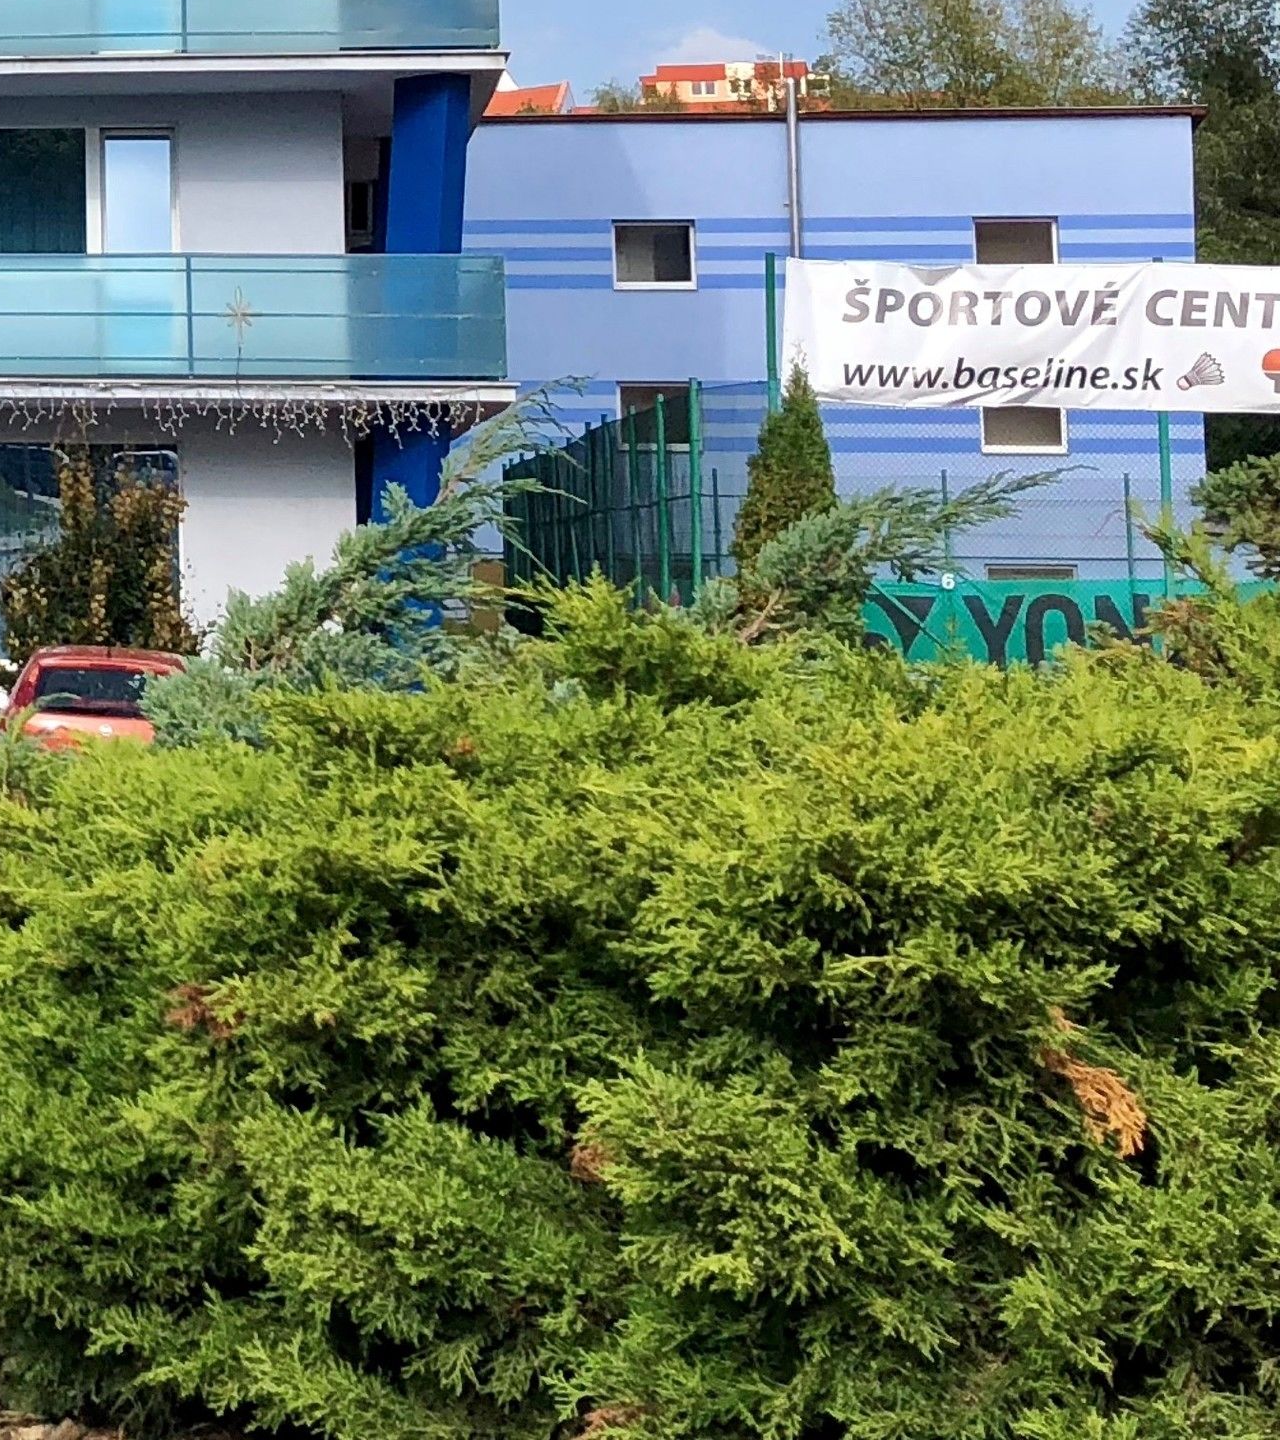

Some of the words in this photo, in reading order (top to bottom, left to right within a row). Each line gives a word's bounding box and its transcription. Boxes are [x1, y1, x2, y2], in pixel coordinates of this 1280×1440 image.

[842, 279, 1122, 328] ŠPORTOVÉ
[1145, 289, 1280, 329] CENT
[842, 358, 1164, 392] www.baseline.sk
[941, 573, 956, 590] 6
[961, 592, 1192, 670] YON
